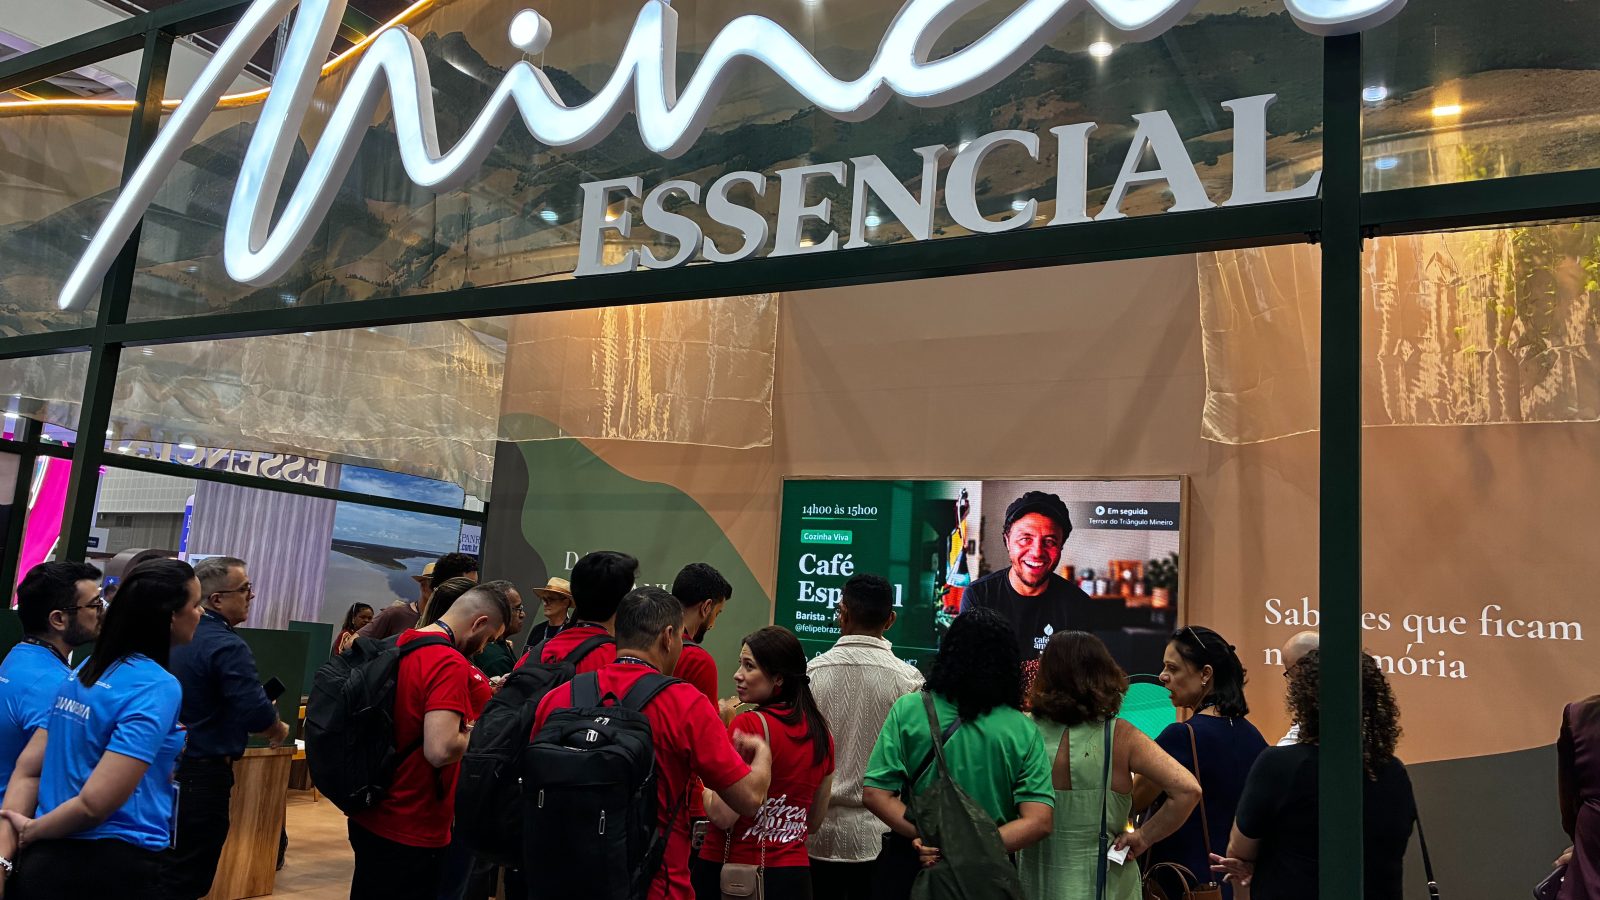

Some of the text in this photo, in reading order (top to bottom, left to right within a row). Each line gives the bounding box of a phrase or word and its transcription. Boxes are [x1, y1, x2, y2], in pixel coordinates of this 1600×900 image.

[574, 94, 1322, 278] ESSENCIAL
[802, 503, 878, 517] 14h00 às 15h00
[1107, 507, 1148, 517] Em seguida
[1120, 518, 1148, 527] Triângulo
[1149, 518, 1174, 526] Mineiro
[803, 532, 849, 542] Cozinha Viva
[798, 553, 854, 577] Café
[797, 580, 904, 609] Espl
[795, 611, 826, 621] Barista
[1264, 596, 1584, 644] Sabes que ficam
[795, 623, 841, 634] @felipebrazz
